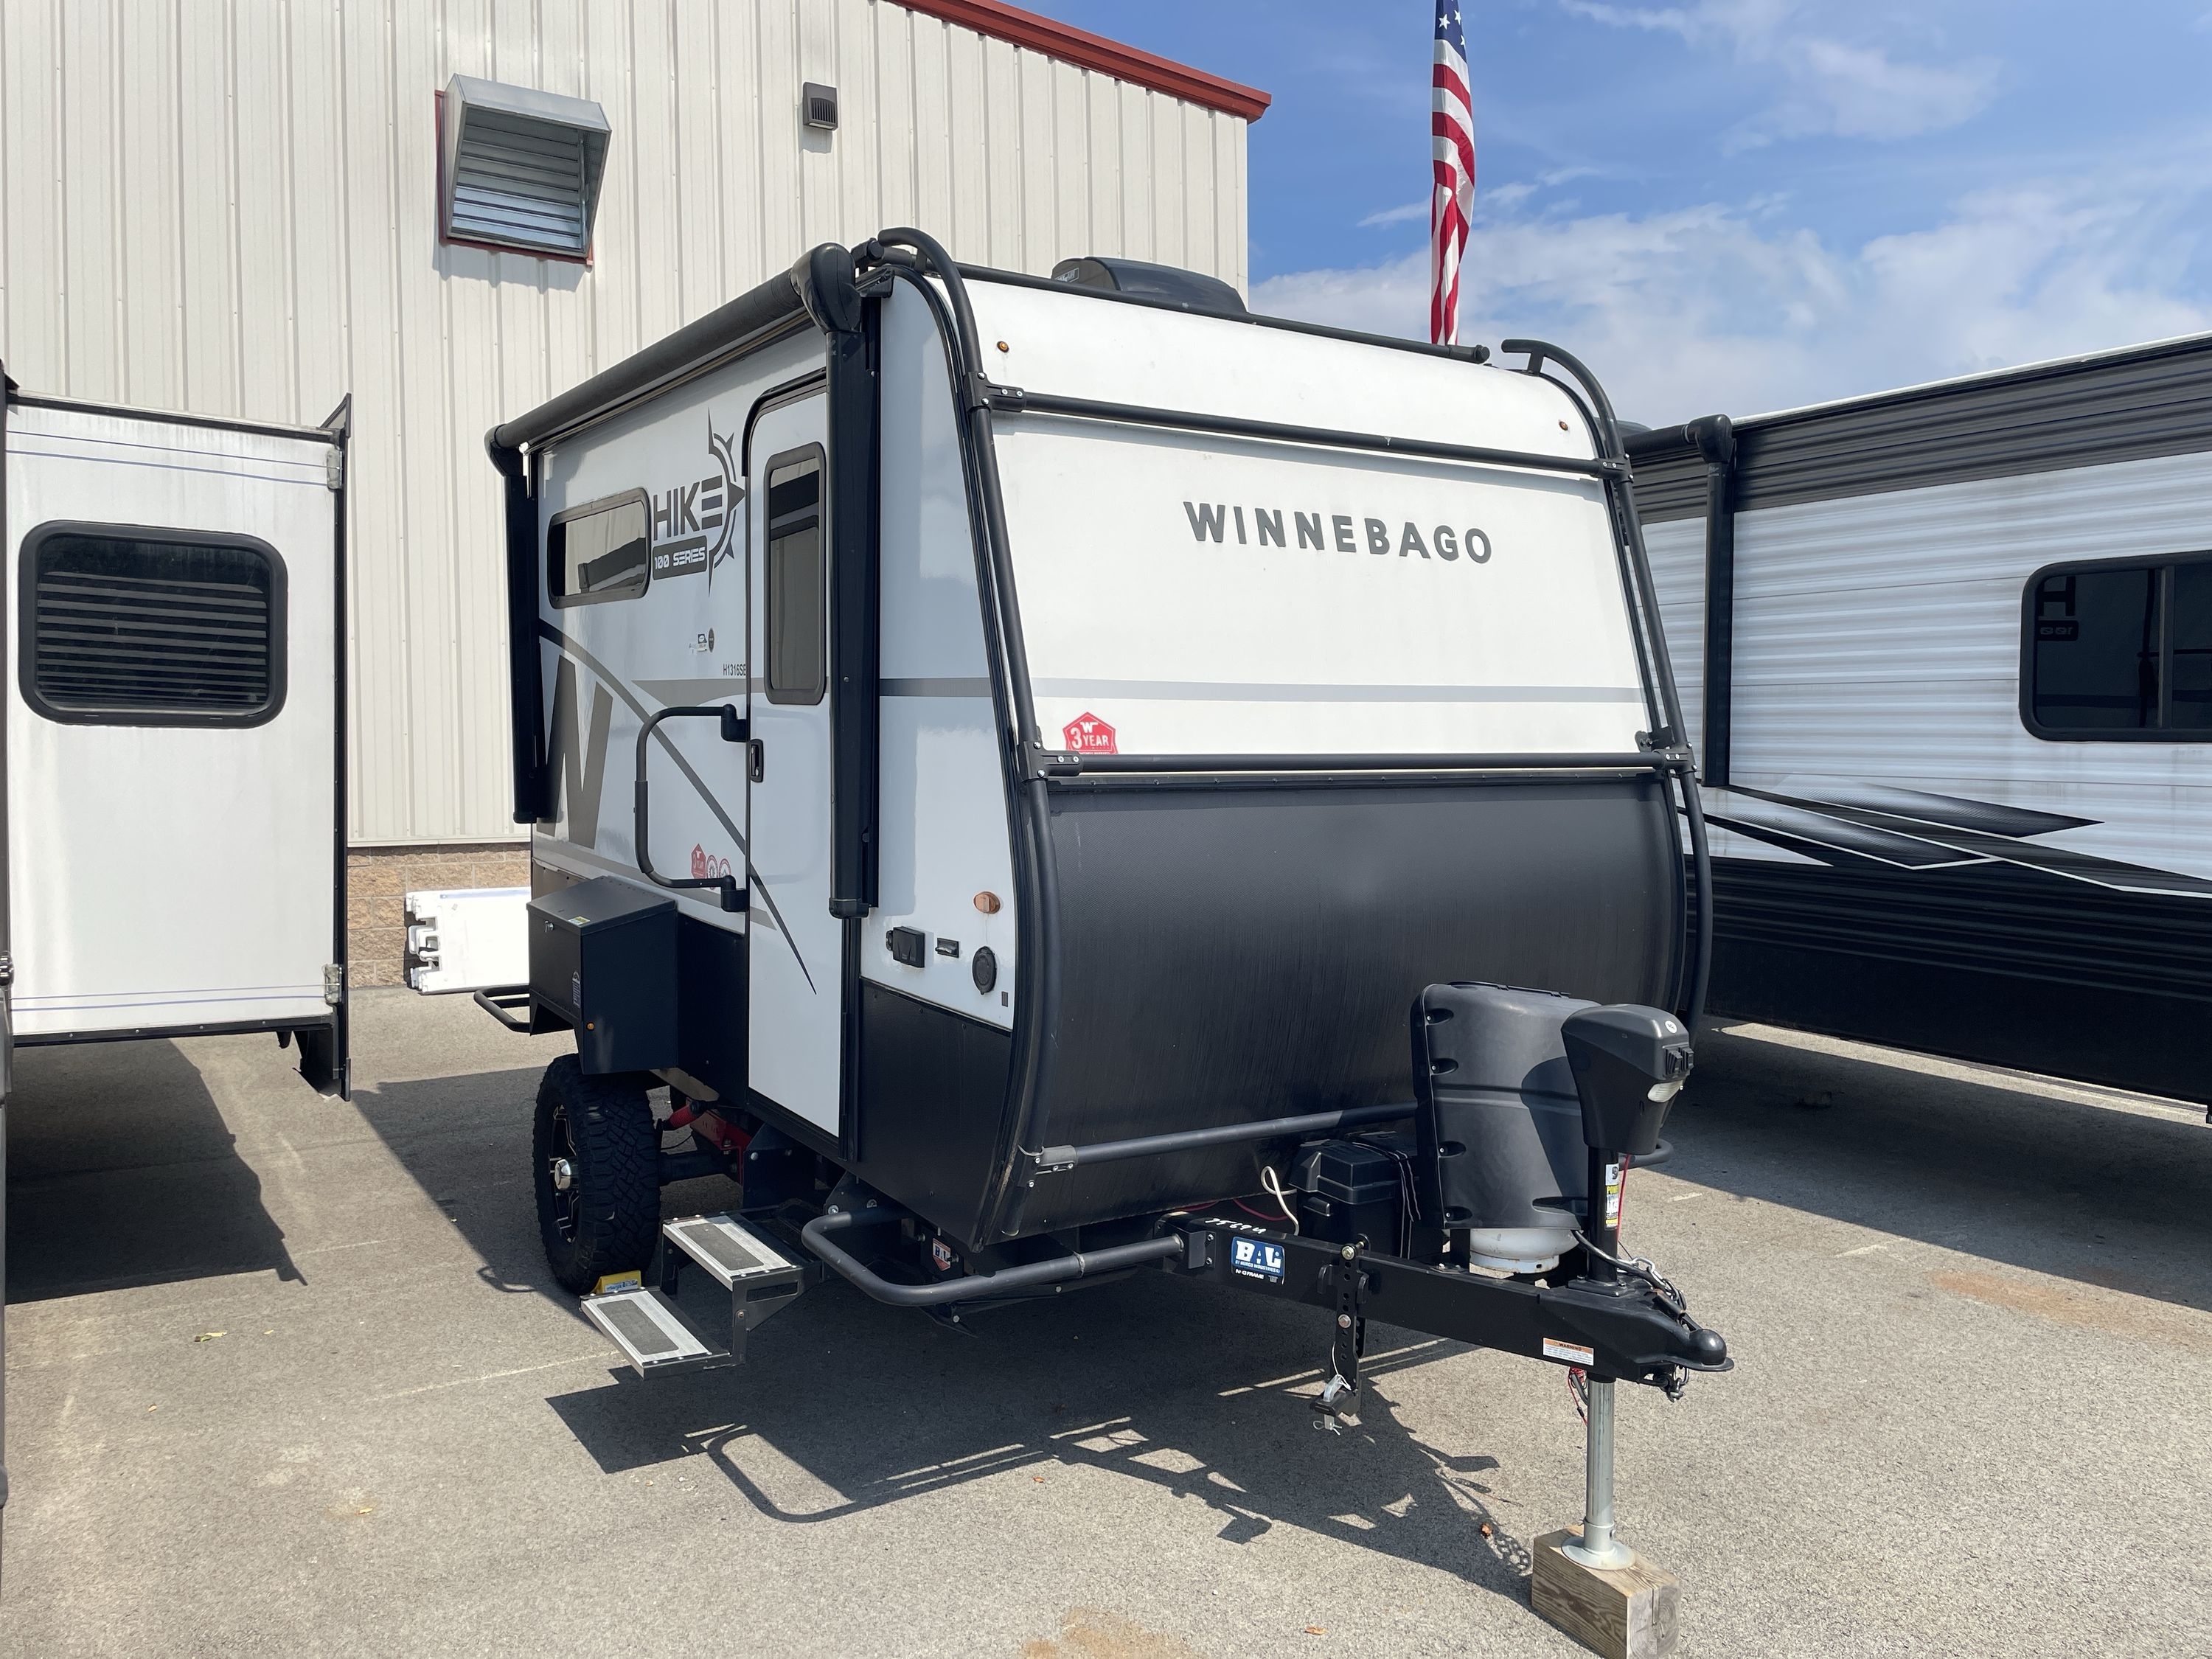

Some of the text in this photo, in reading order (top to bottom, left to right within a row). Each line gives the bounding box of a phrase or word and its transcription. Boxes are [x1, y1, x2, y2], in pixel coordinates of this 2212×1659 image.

[653, 475, 723, 540] HIKE
[1183, 501, 1492, 564] WINNEBAGO
[655, 546, 706, 569] 100 SERIES
[1070, 726, 1110, 749] 3 YEAR
[1236, 1240, 1281, 1269] BAL
[1558, 1342, 1582, 1352] WARNING
